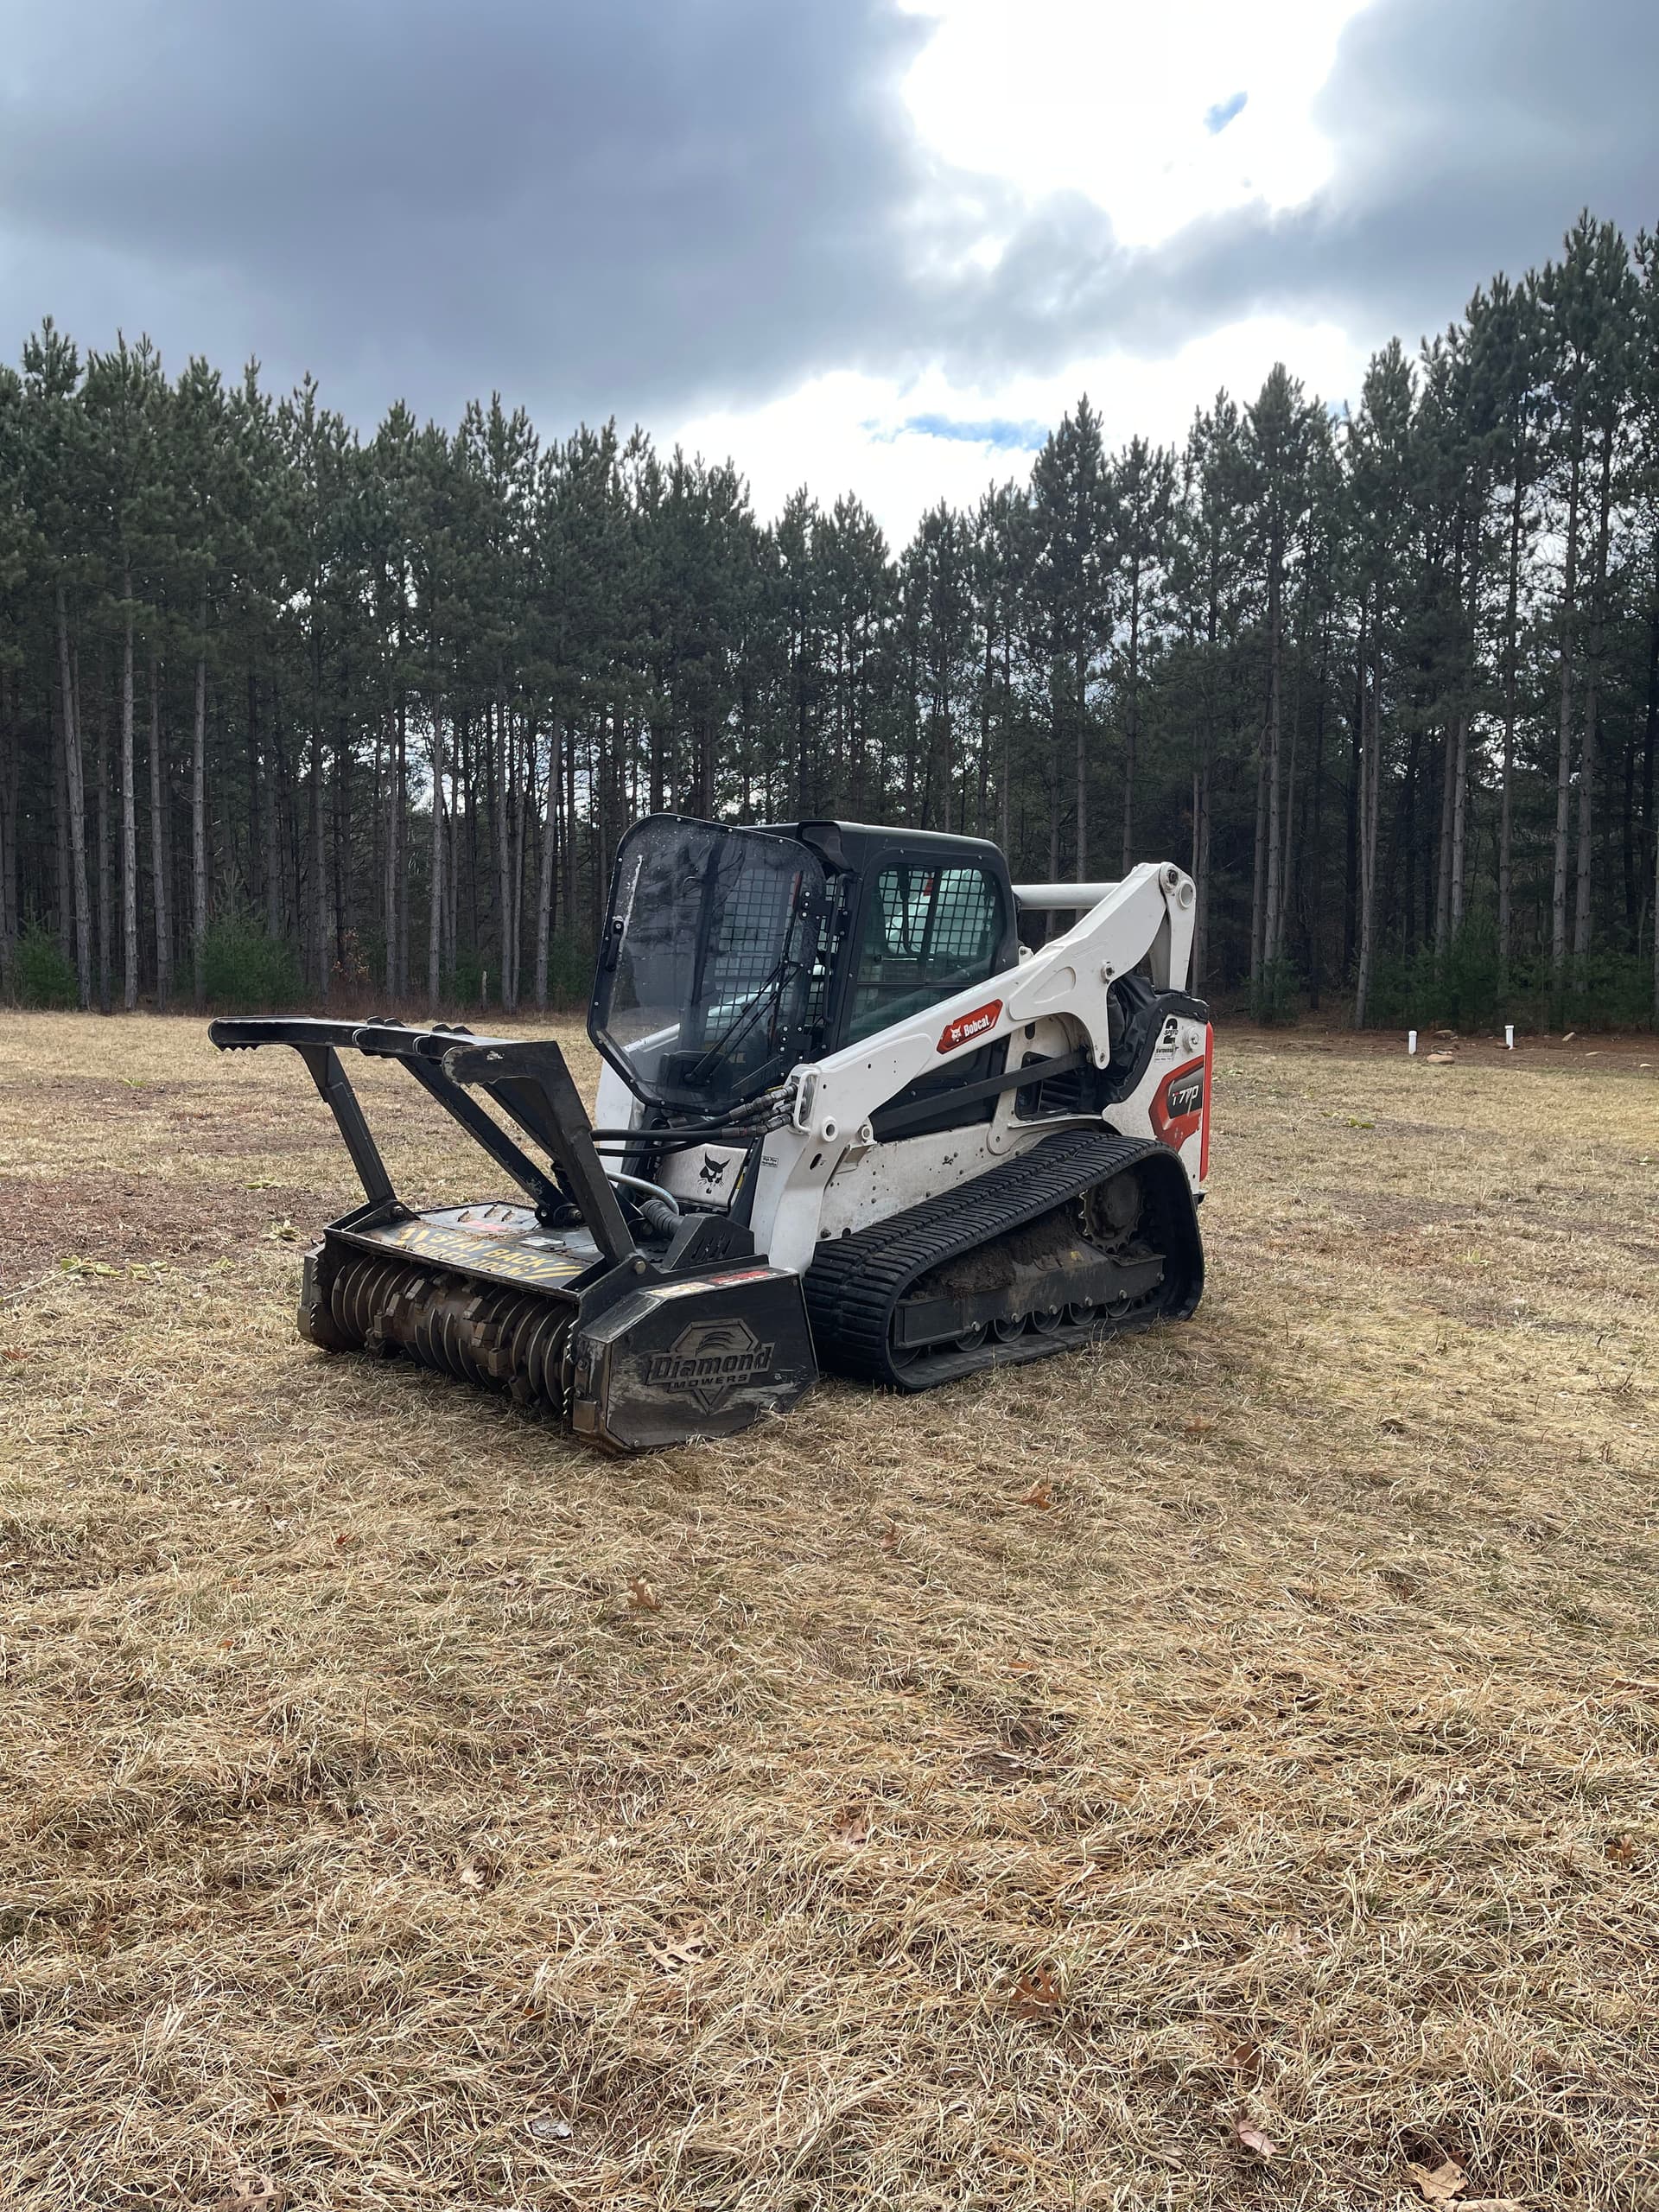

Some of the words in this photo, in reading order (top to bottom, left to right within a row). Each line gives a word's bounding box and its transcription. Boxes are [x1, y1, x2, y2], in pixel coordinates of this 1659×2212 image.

[963, 1014, 990, 1037] Bobcat
[1163, 1018, 1179, 1044] 2
[429, 1232, 492, 1252] STAY
[483, 1249, 553, 1268] BACK
[651, 1346, 772, 1379] Diamond
[672, 1373, 748, 1389] MOWERS
